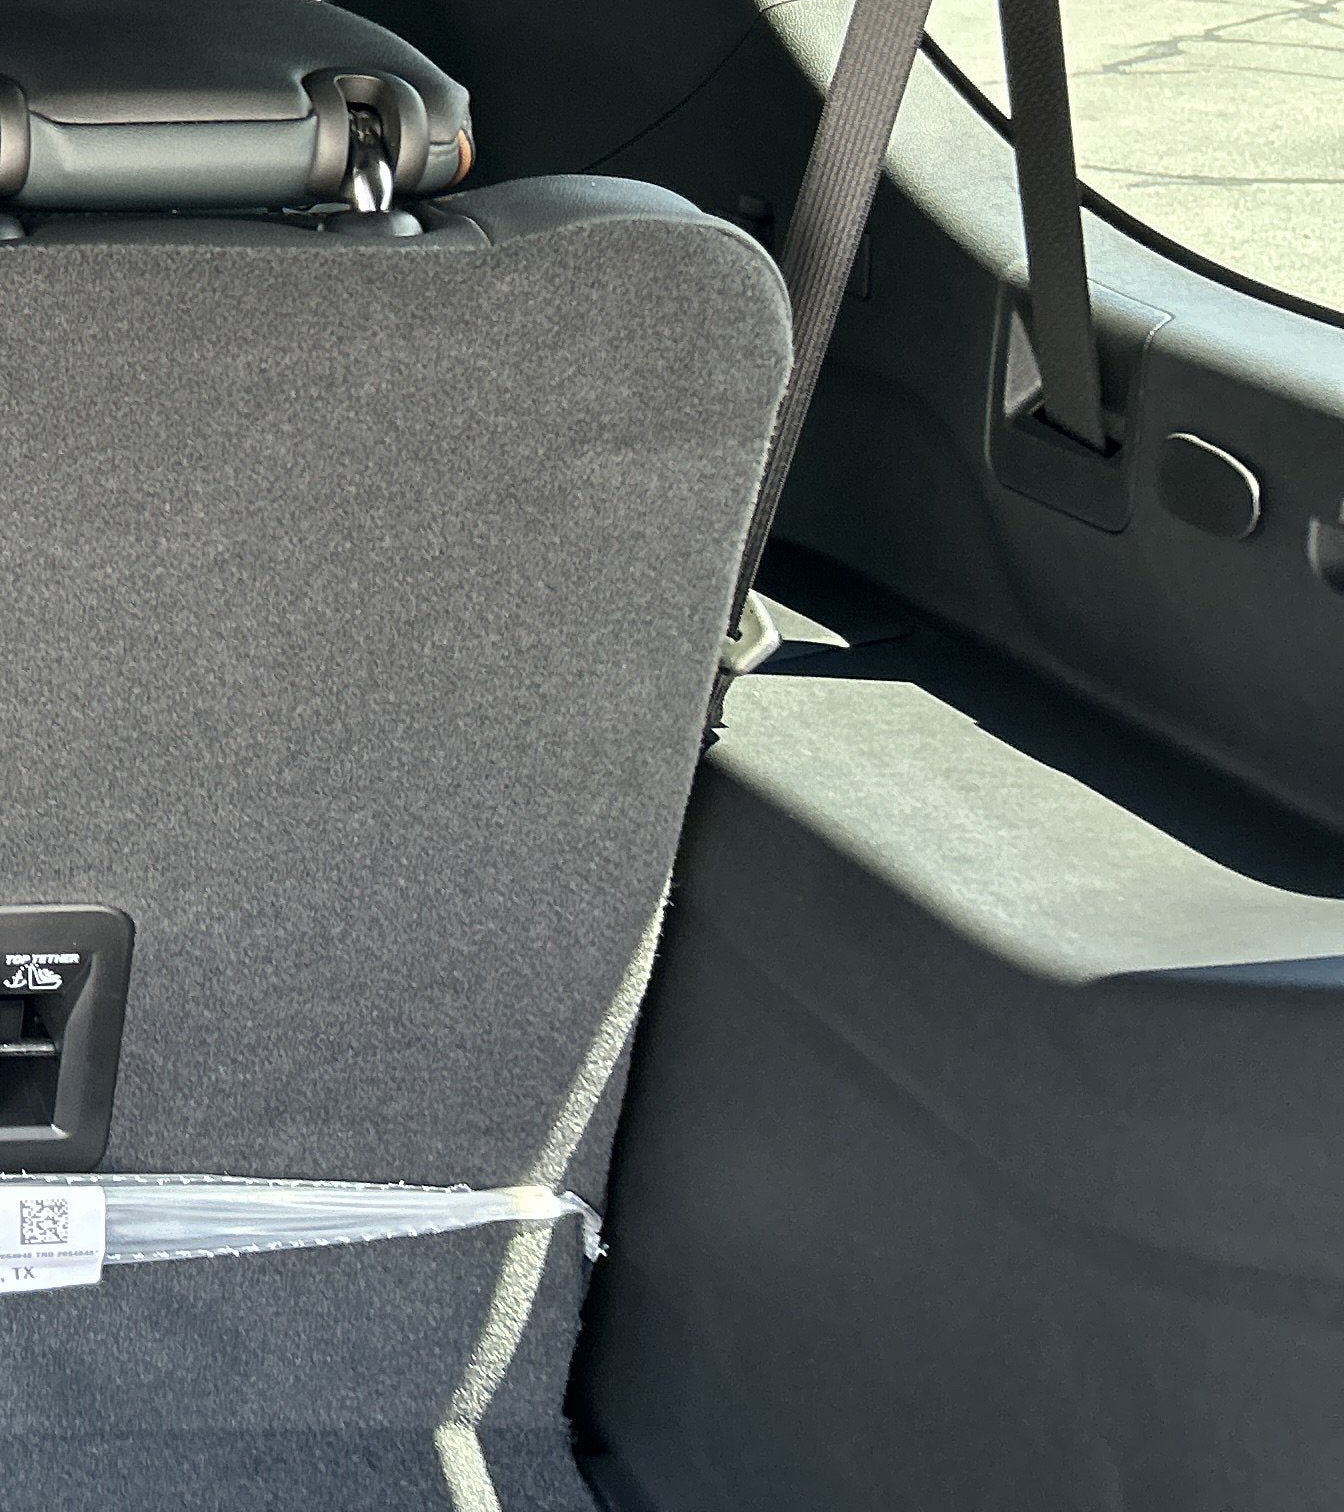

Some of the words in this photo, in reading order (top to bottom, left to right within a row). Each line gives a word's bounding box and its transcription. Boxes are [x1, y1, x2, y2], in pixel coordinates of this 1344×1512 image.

[6, 954, 31, 966] TOP
[31, 953, 80, 964] TETHER
[12, 1266, 36, 1281] TX
